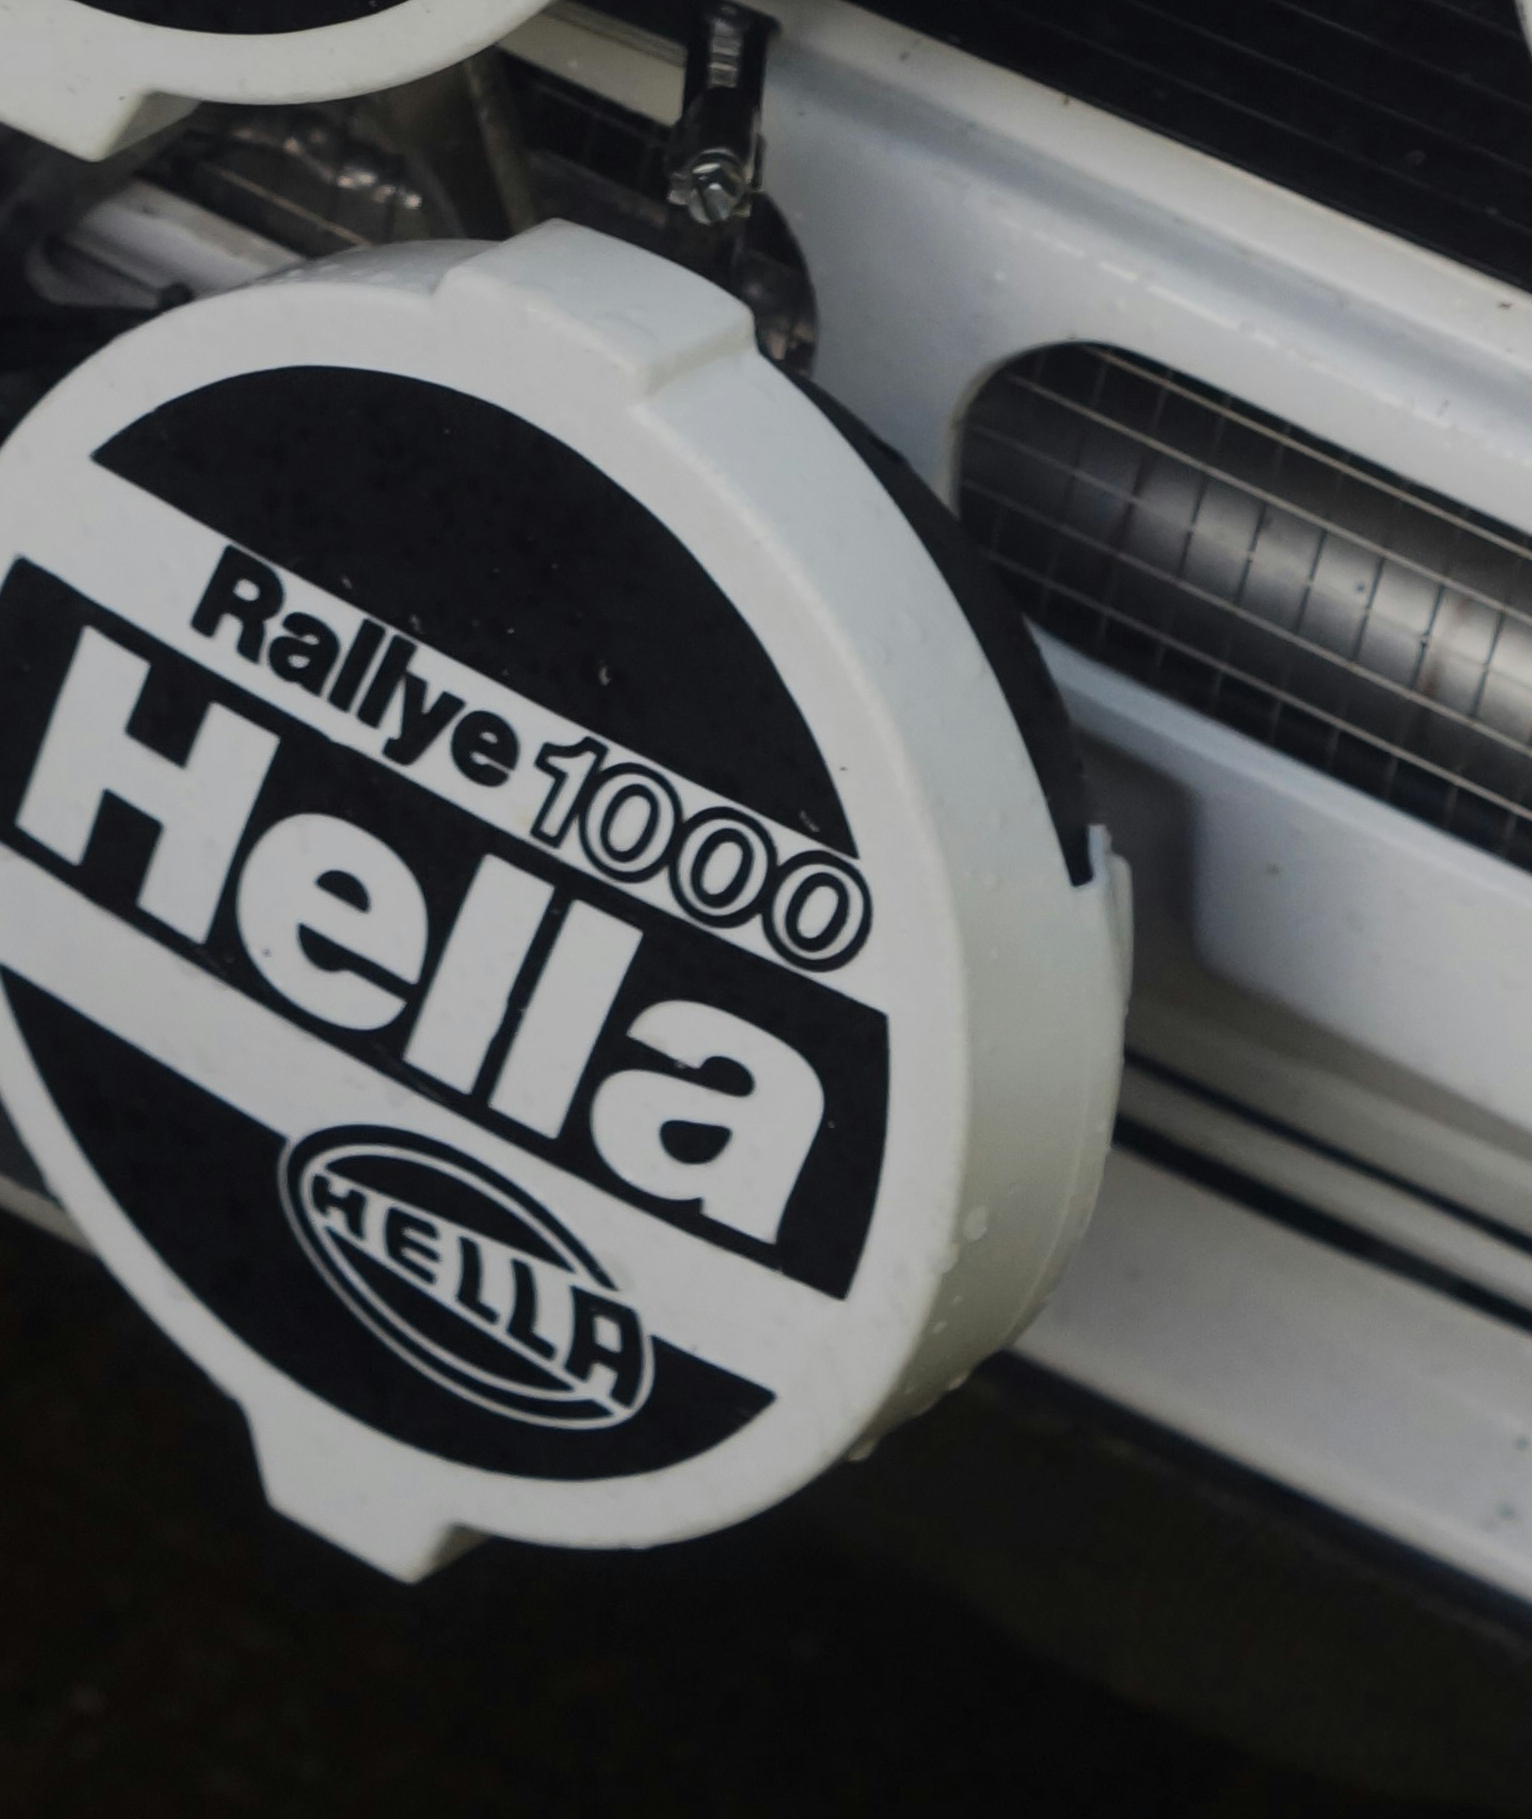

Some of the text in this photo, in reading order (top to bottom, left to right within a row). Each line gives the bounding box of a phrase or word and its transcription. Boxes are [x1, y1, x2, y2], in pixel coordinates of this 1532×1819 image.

[14, 624, 826, 1245] Hella
[190, 544, 873, 972] Rallye 1000
[313, 1175, 647, 1410] HELLA
